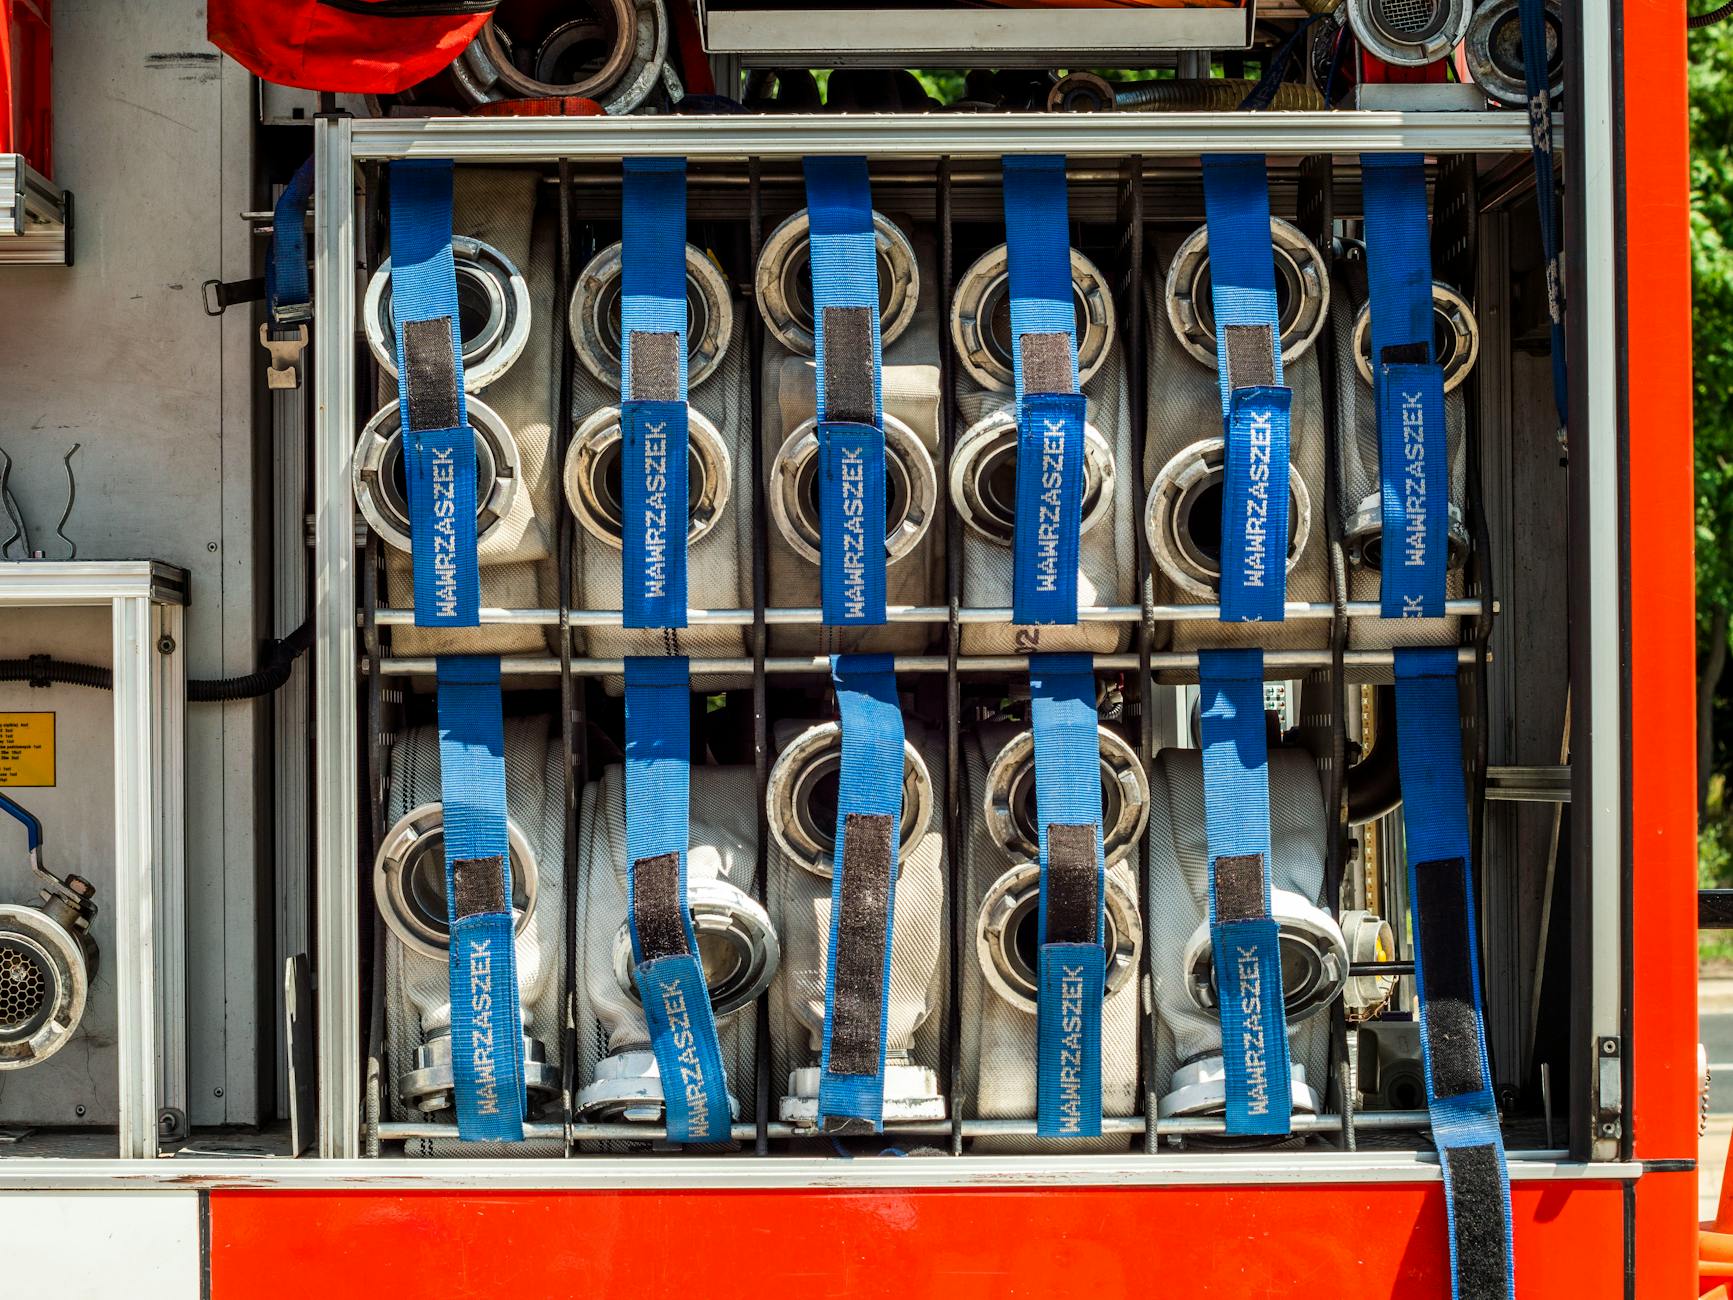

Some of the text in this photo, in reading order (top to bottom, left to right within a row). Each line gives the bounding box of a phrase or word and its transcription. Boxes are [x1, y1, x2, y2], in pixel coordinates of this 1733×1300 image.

[433, 449, 456, 616] WAWRZASZEK
[645, 423, 666, 597] WAWRZASZEK
[842, 448, 864, 617] WAWRZASZEK
[1037, 420, 1065, 590] WAWRZASZEK
[1244, 412, 1271, 586] WAWRZASZEK
[1403, 391, 1425, 565] WAWRZASZEK
[471, 939, 498, 1114] WAWRZASZEK
[658, 978, 710, 1137] WAWRZASZEK
[1060, 966, 1083, 1133] WAWRZASZEK
[1237, 945, 1268, 1115] WAWRZASZEK
